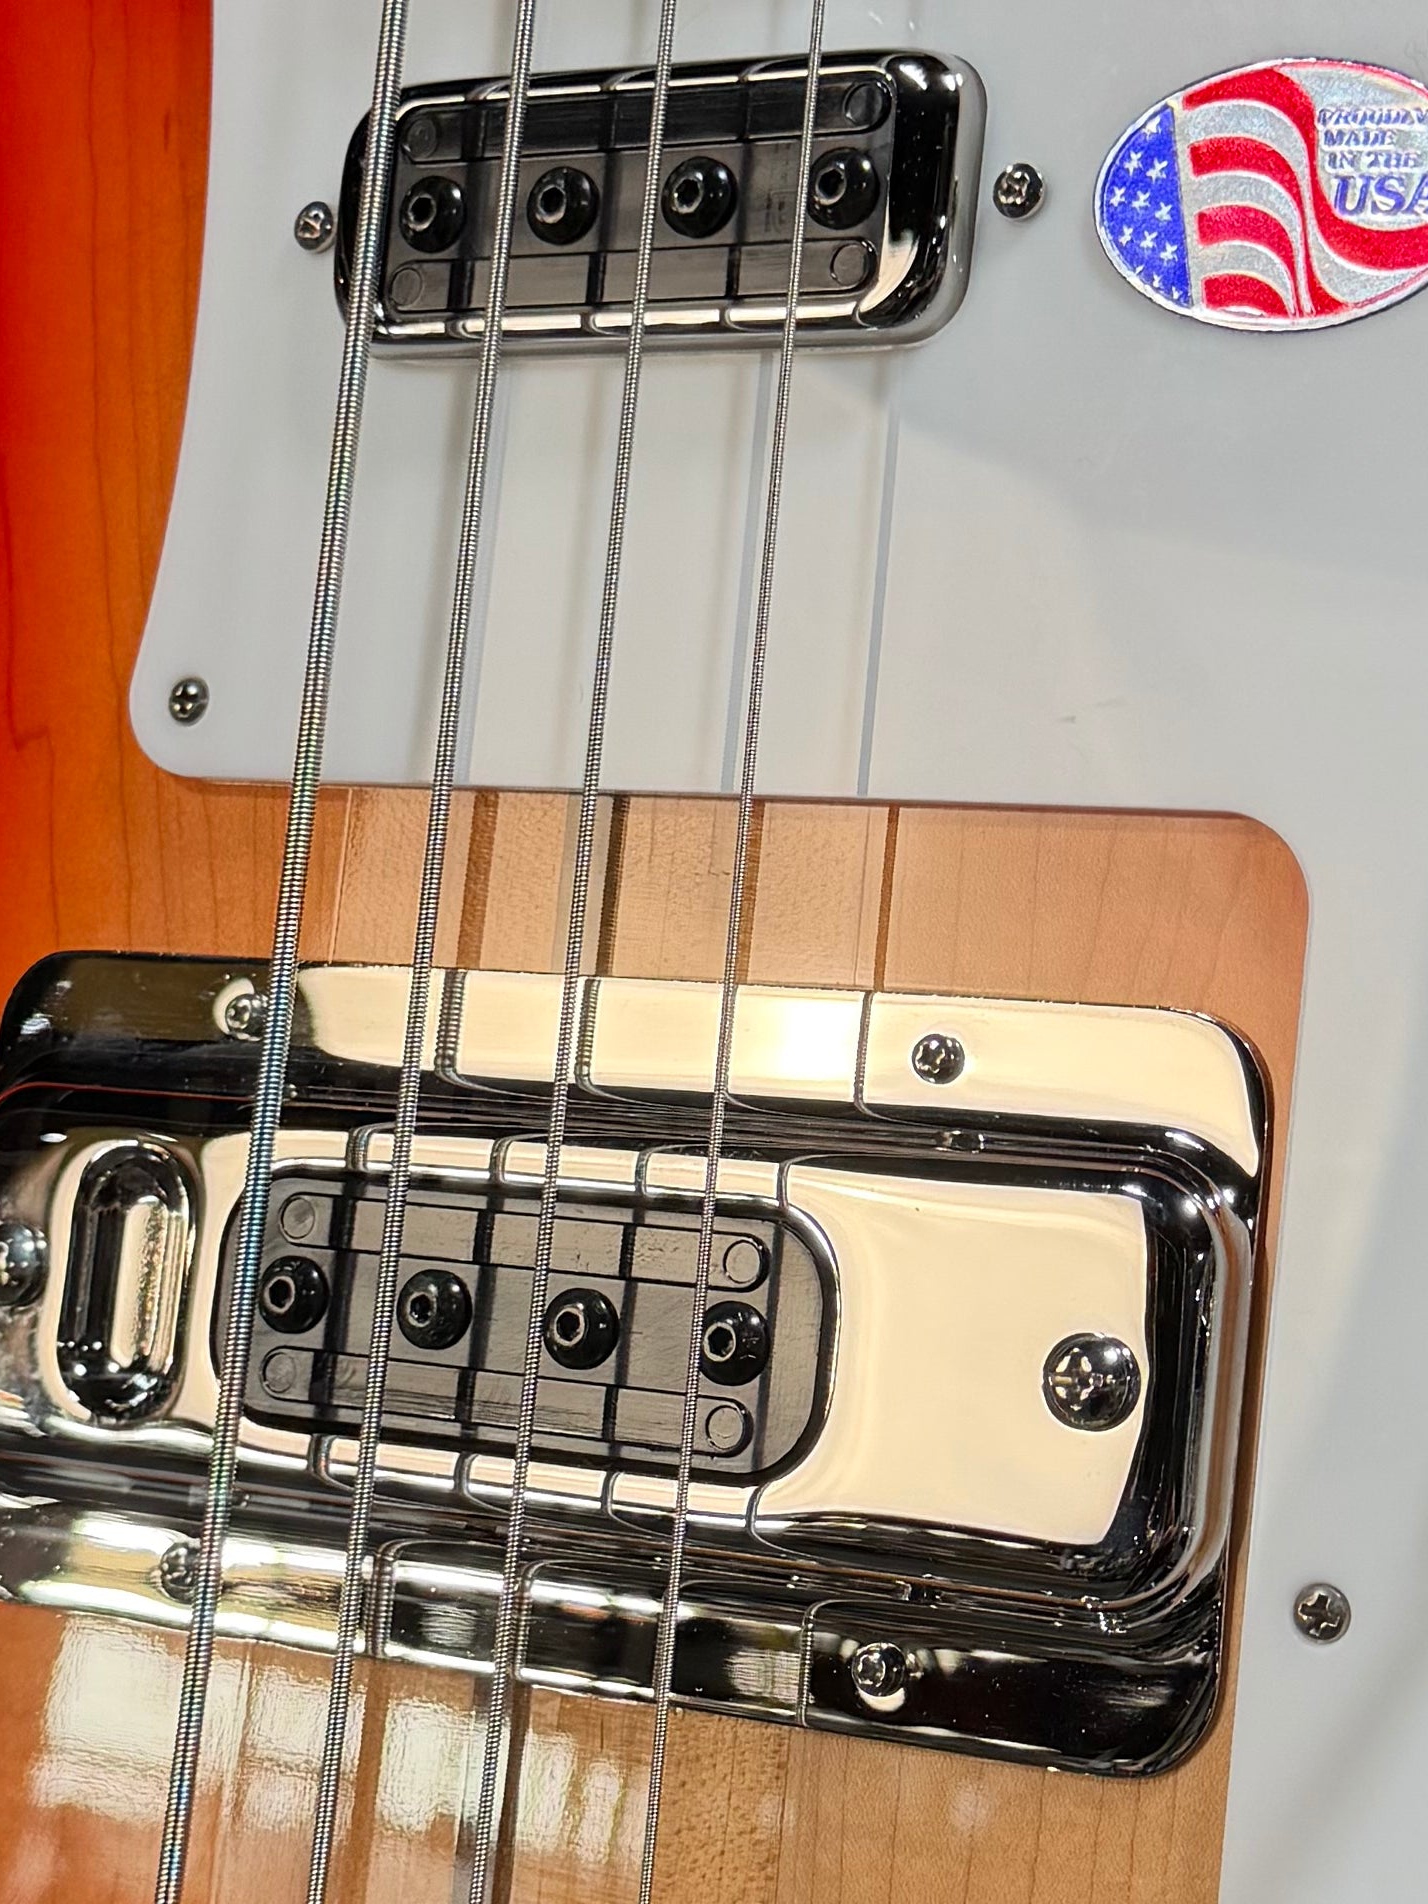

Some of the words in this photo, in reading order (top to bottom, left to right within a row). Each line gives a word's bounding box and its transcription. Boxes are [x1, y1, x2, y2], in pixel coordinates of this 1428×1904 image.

[1324, 129, 1396, 146] MADE
[1327, 151, 1356, 169] IN
[1366, 151, 1422, 168] THE
